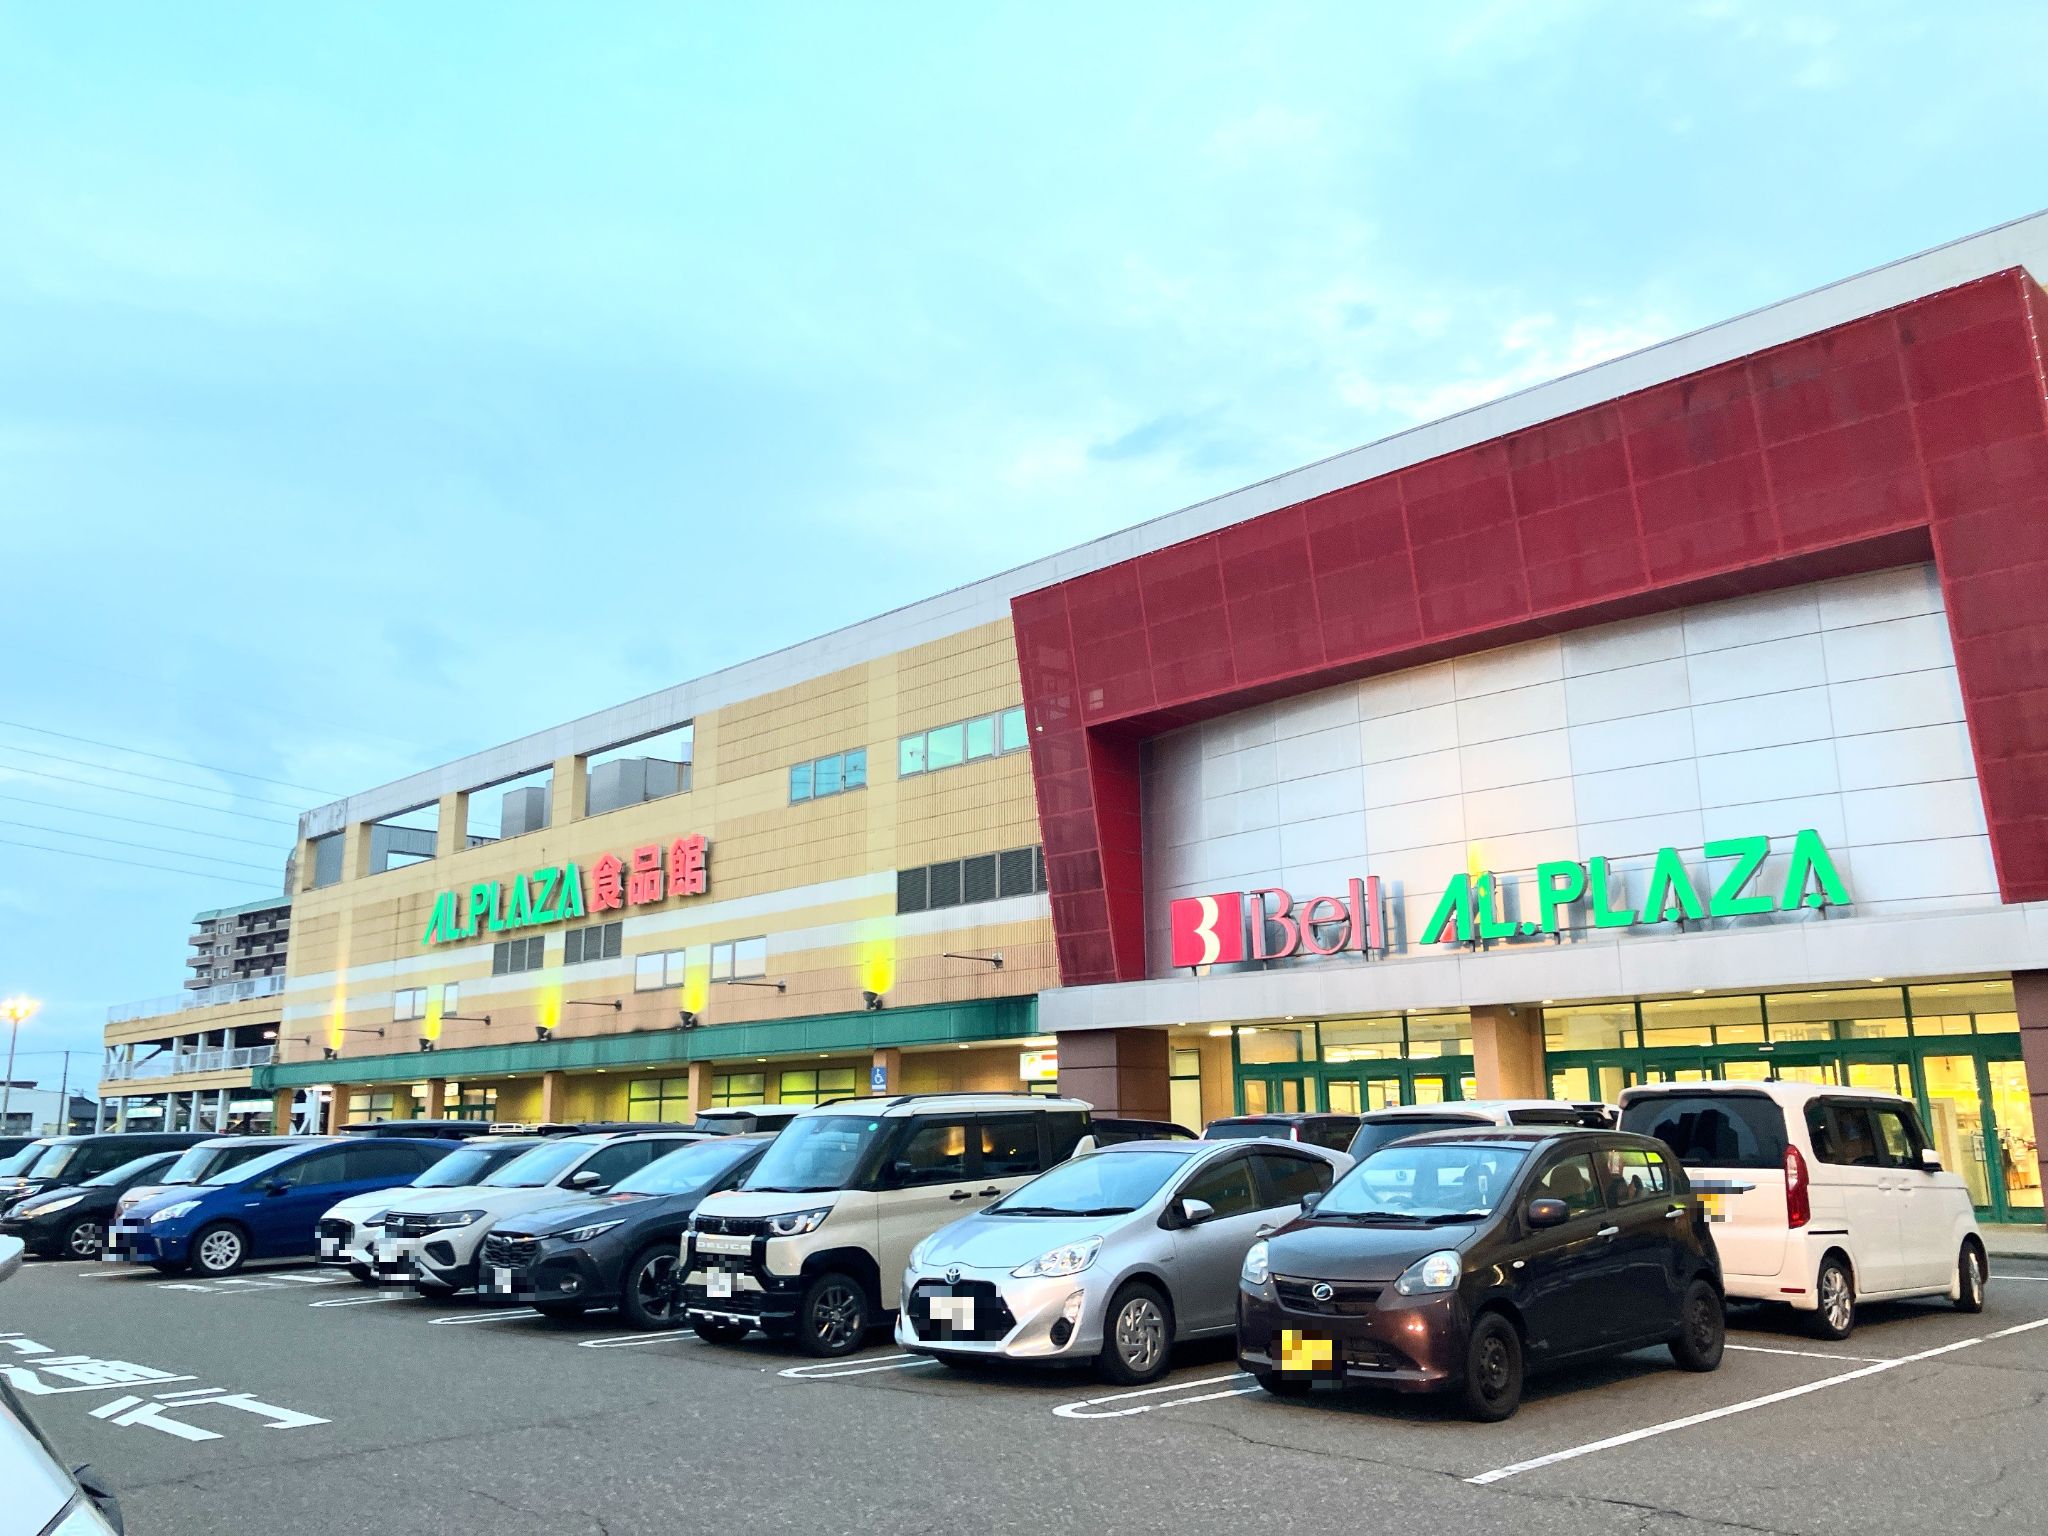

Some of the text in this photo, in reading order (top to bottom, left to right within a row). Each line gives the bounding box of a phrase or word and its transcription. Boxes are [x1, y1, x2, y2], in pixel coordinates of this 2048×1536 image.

[424, 834, 708, 944] AL.PLAZA 食品館
[1250, 876, 1384, 960] Bell
[1420, 829, 1851, 945] AL.PLAZA
[697, 1241, 751, 1250] DELICA
